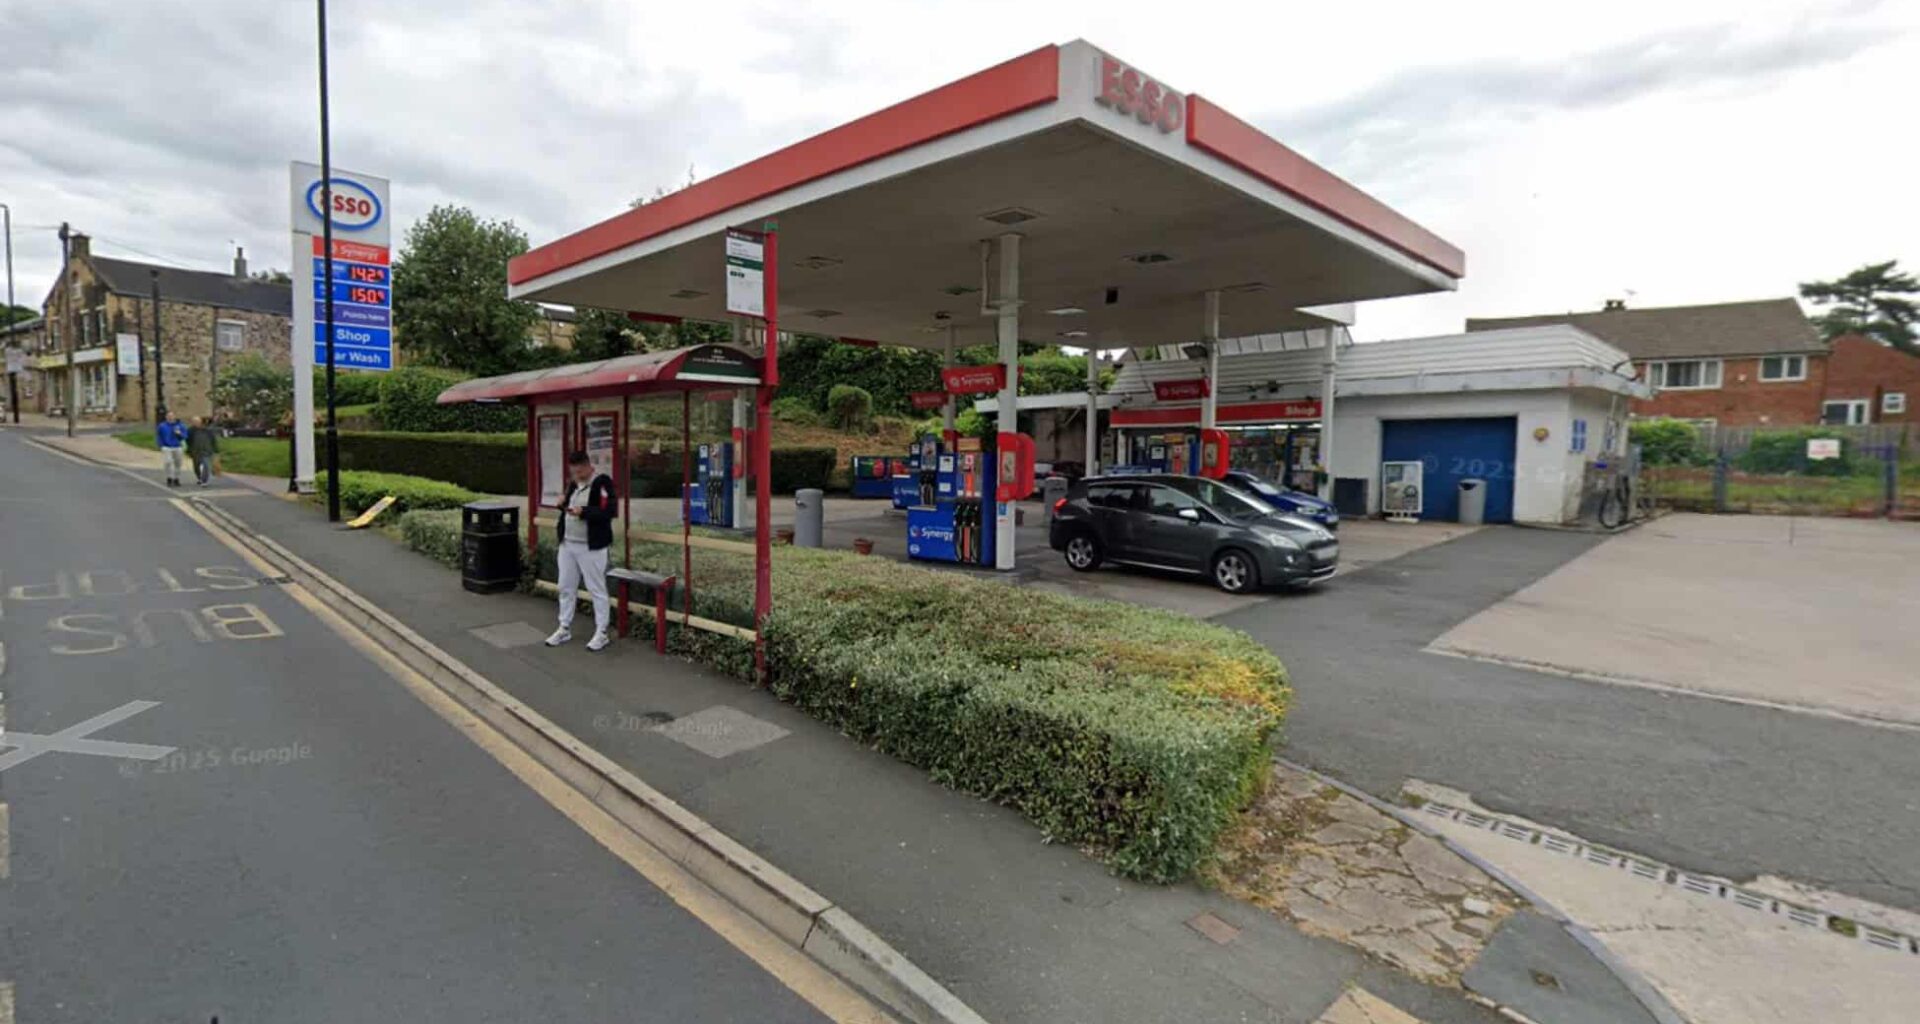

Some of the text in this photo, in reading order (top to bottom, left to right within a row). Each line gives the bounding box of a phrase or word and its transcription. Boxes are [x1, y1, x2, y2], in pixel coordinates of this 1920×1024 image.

[336, 328, 371, 344] Shop
[349, 351, 381, 363] Wash
[961, 375, 995, 387] Synergy
[1285, 405, 1316, 416] Shop
[921, 527, 954, 541] Synergy
[8, 566, 258, 600] STOP
[48, 603, 285, 654] BUS
